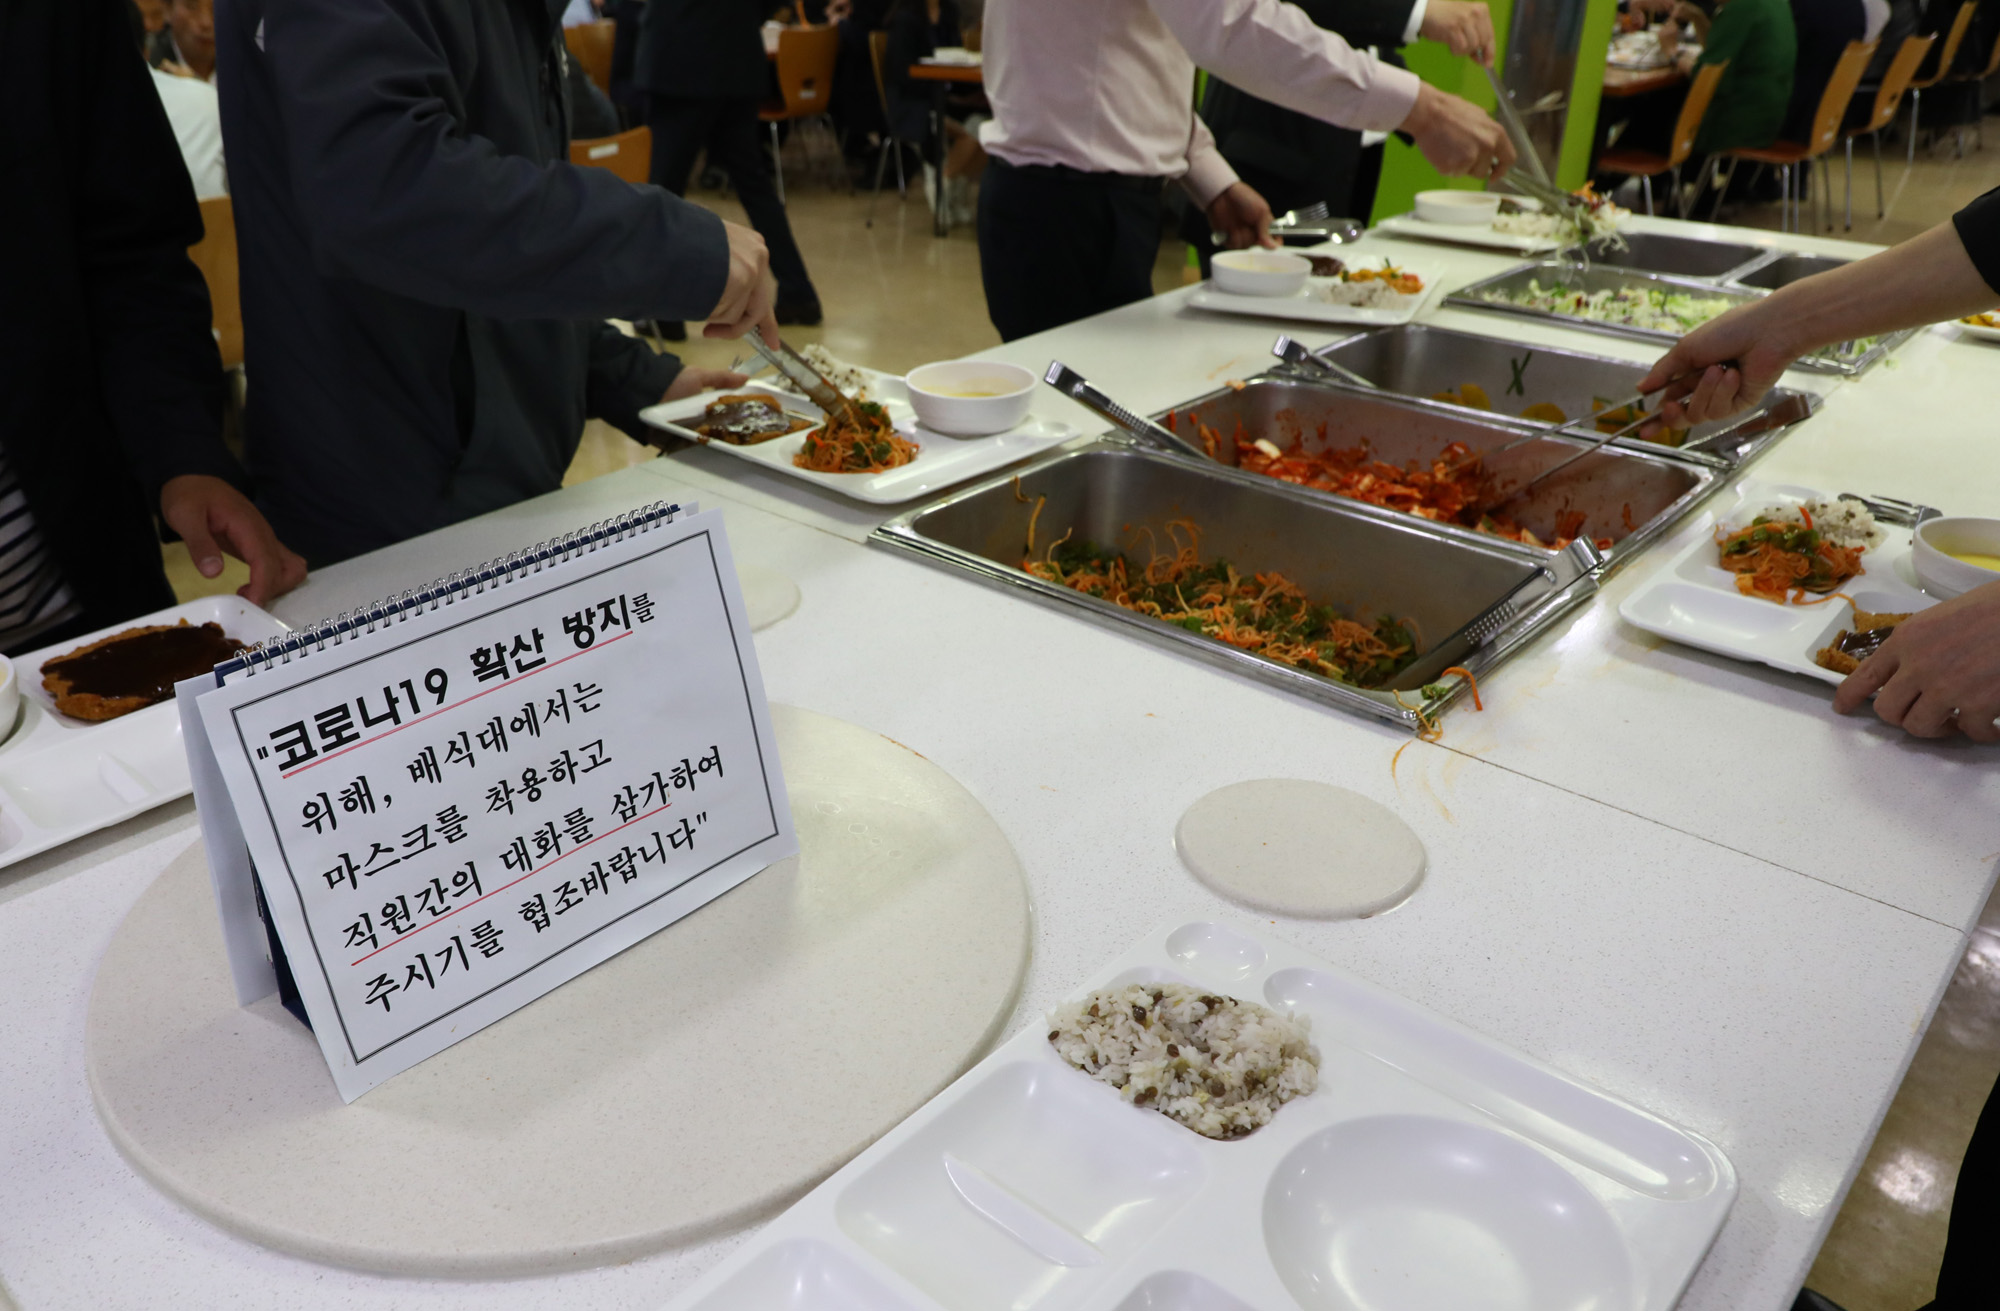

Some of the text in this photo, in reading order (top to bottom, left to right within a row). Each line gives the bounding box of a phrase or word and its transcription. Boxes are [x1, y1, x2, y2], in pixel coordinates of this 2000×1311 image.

[256, 592, 655, 772] "코로나19 확산 방지를
[301, 680, 604, 835] 위해, 배식대에서는
[323, 739, 612, 891] 마스크를 착용하고
[344, 746, 725, 950] 직원간의 대화를 삼가하여
[364, 811, 708, 1012] 주시기를 협조바랍니다"
